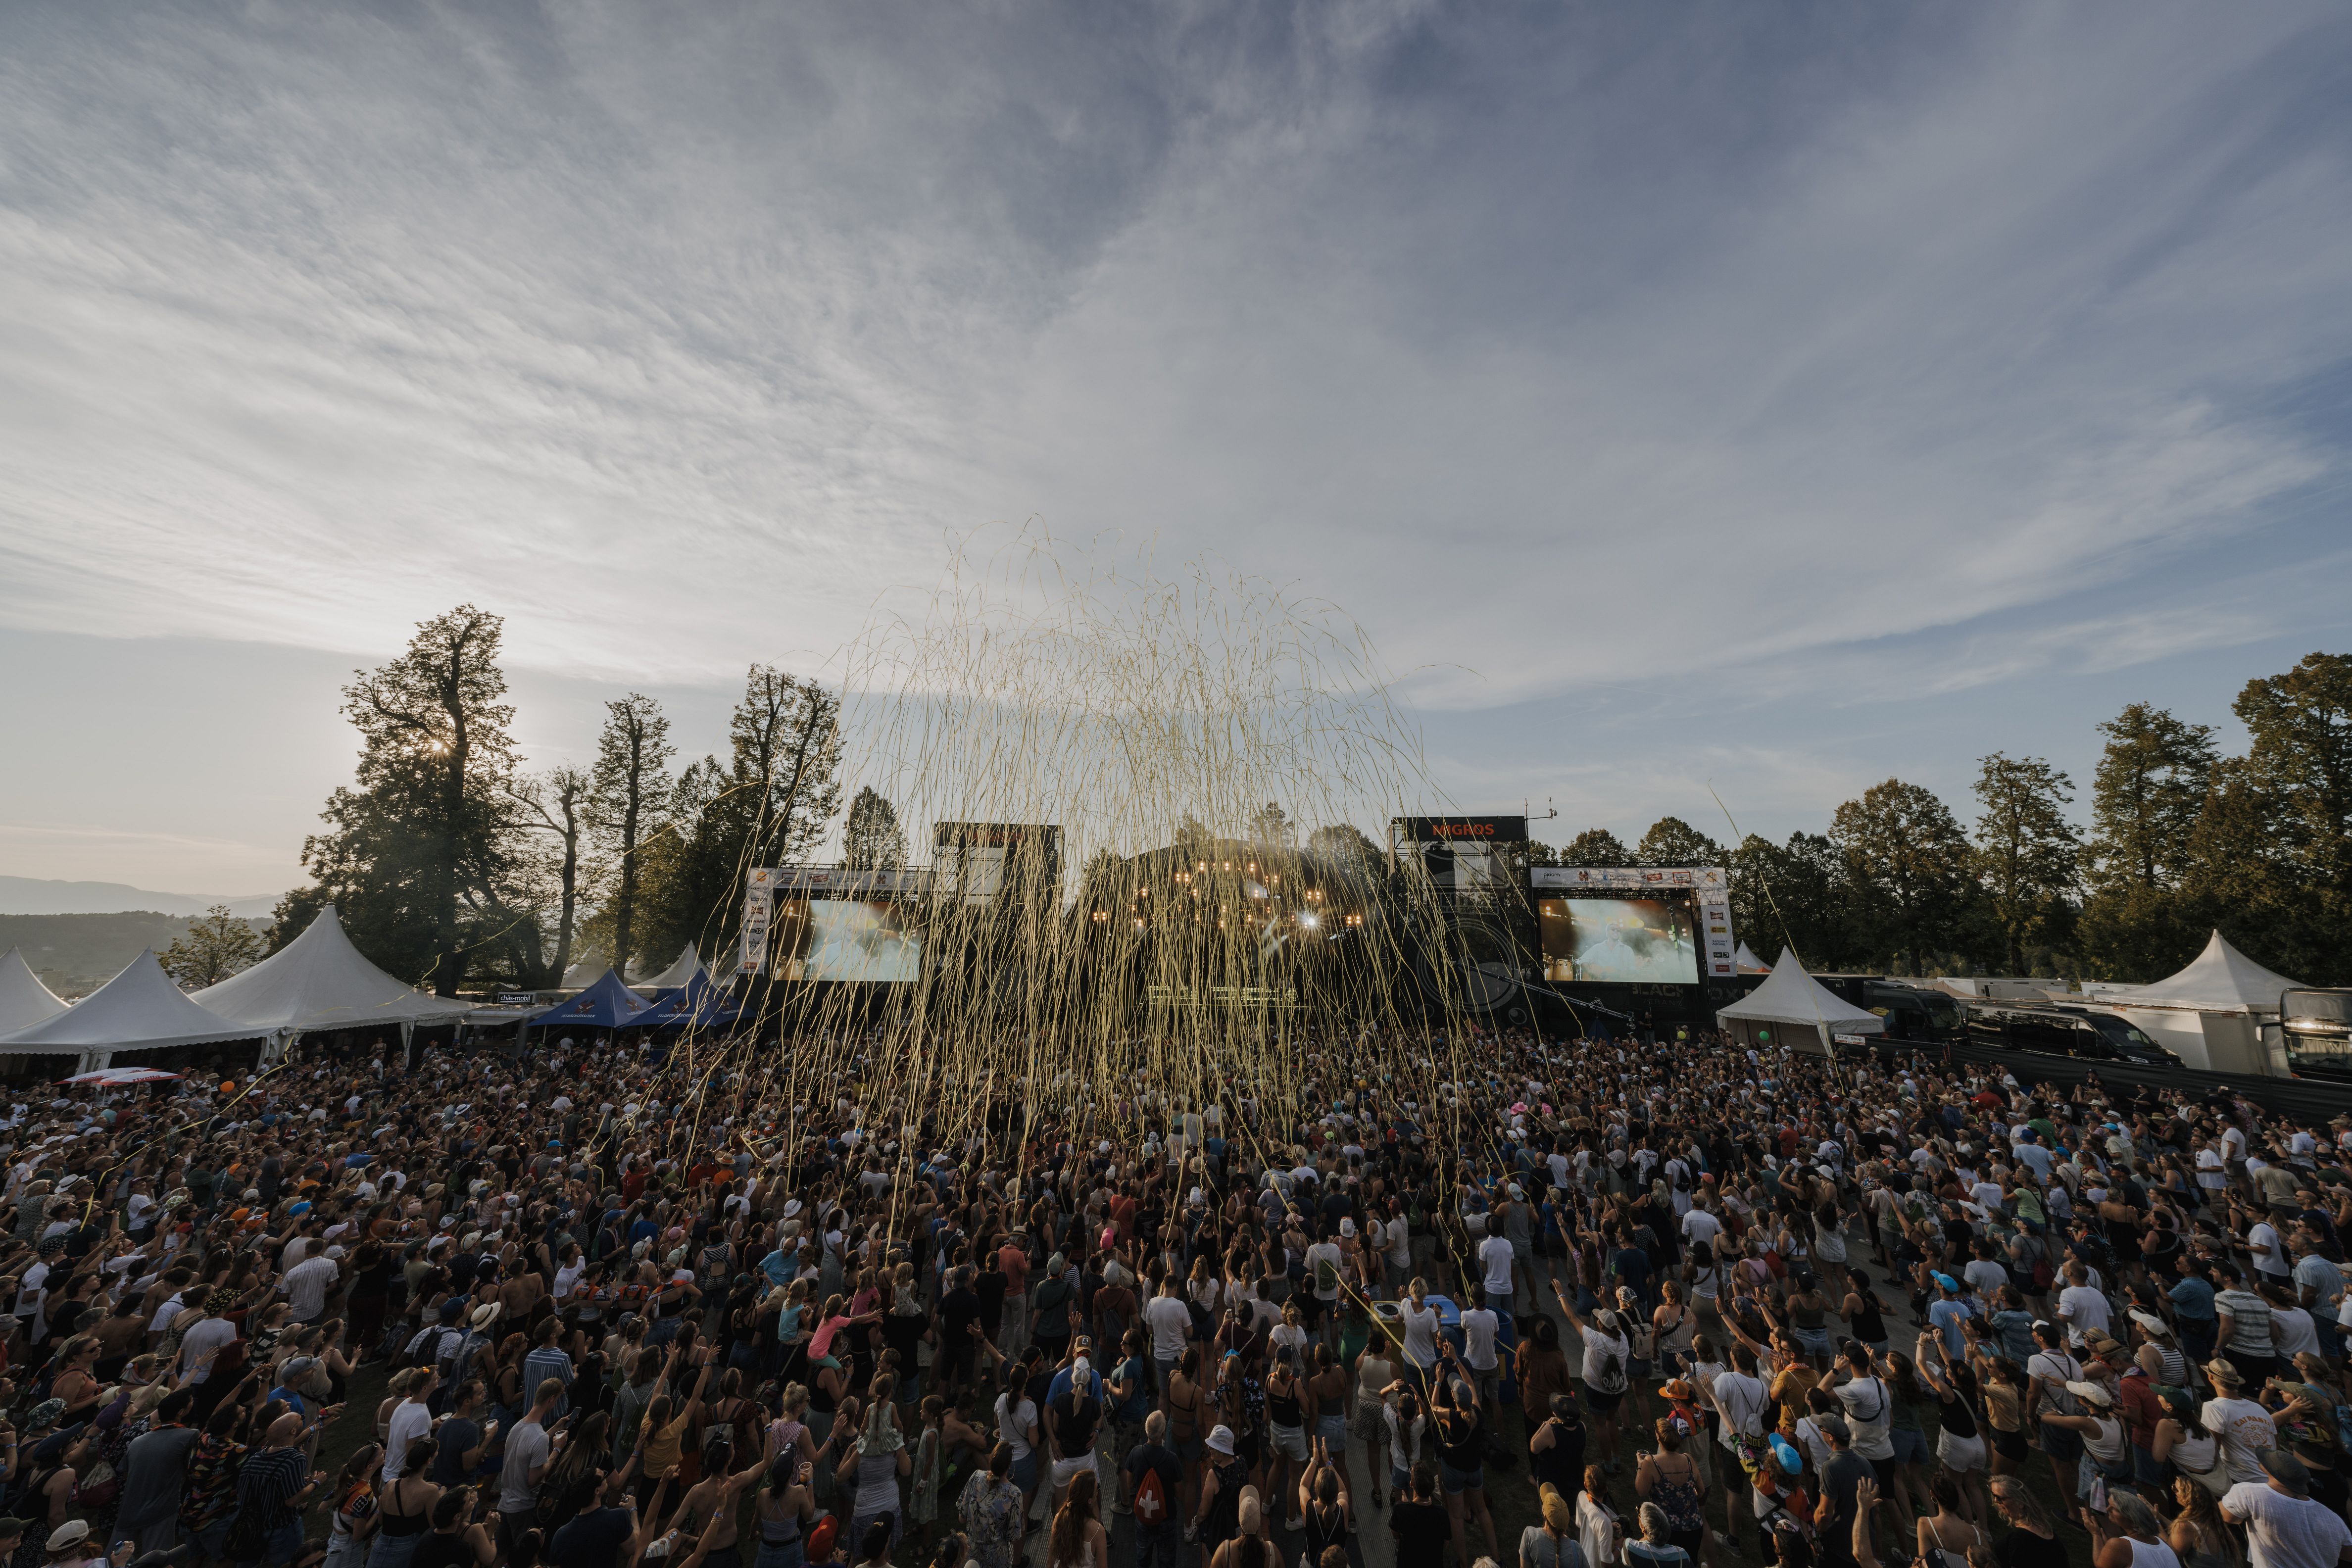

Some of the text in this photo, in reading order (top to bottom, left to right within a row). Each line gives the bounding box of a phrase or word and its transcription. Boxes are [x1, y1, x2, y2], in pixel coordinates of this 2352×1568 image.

[1433, 824, 1495, 835] MIGROS
[1543, 871, 1560, 880] ploom
[2234, 1416, 2248, 1427] EAT
